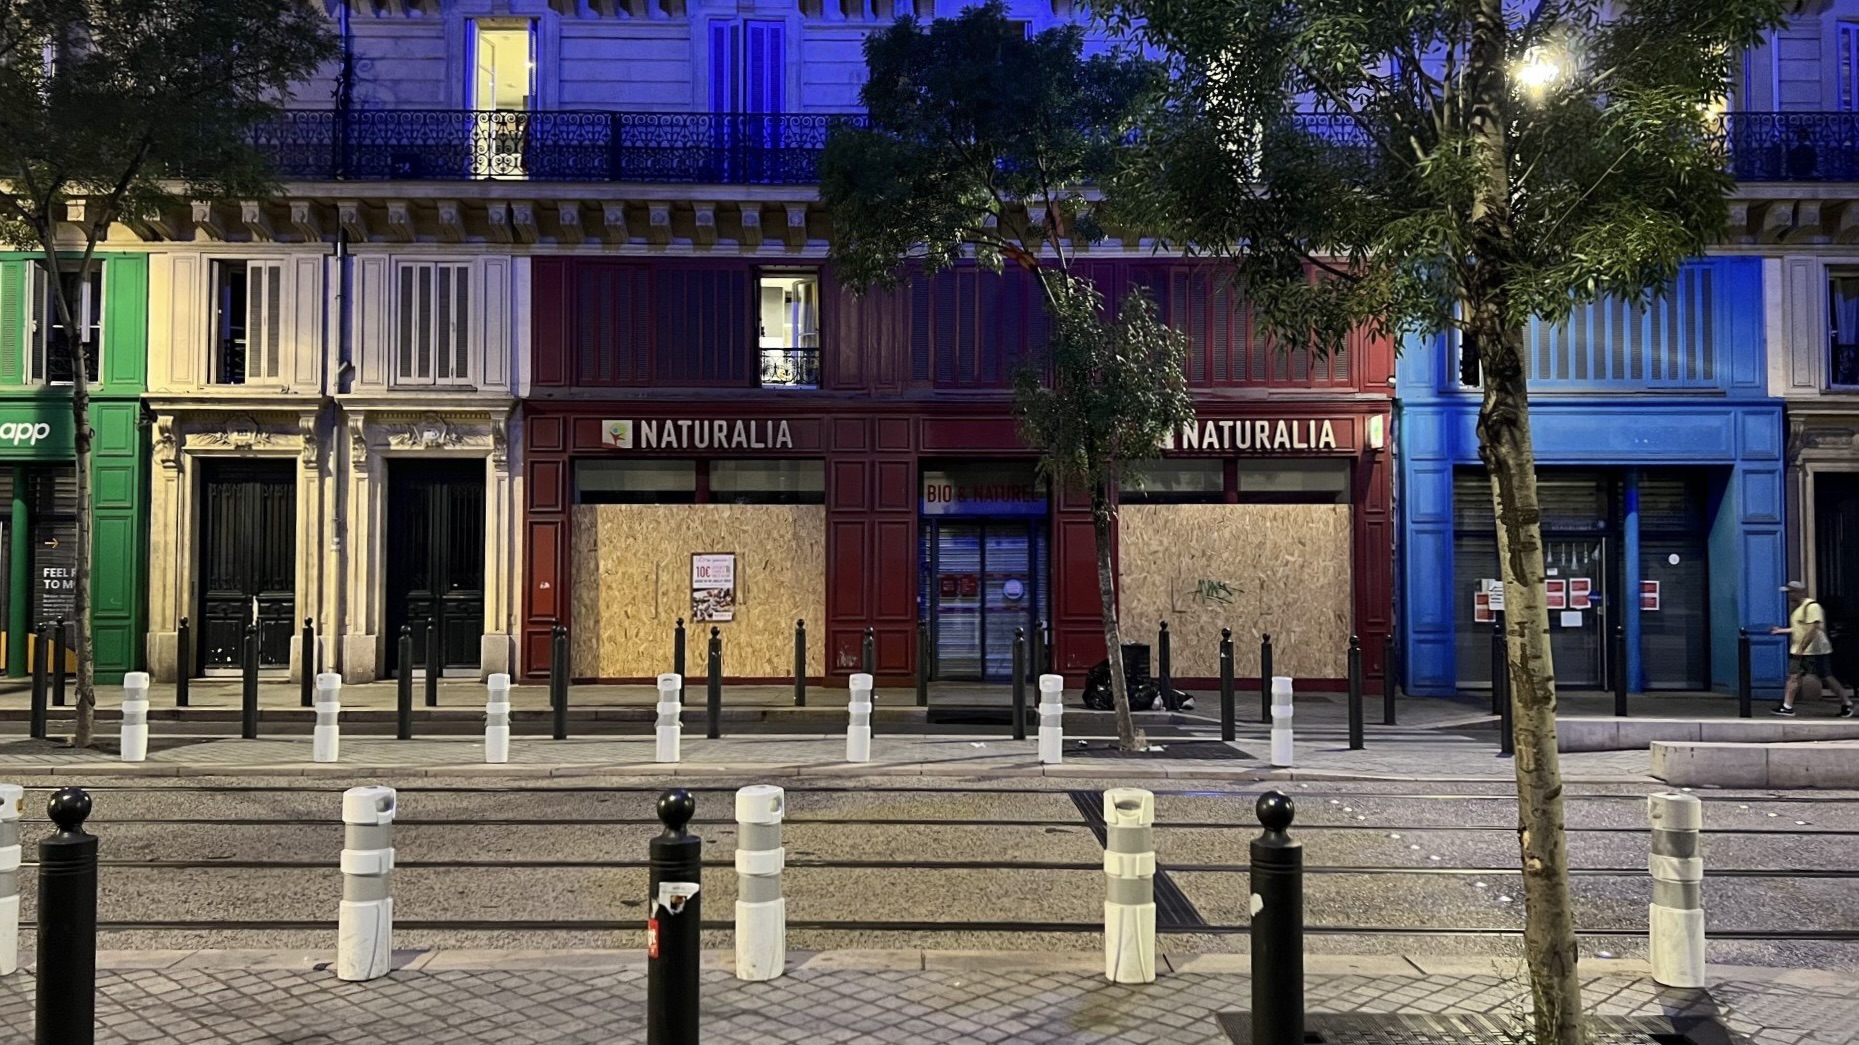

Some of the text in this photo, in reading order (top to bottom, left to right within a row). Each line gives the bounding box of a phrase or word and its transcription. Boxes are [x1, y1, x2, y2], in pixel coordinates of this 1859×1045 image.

[640, 419, 793, 449] NATURALIA
[1182, 419, 1337, 450] NATURALIA
[926, 484, 1040, 503] BIO & NATUREL
[43, 567, 69, 578] FEEL
[696, 565, 711, 578] 10€
[43, 579, 61, 589] TO
